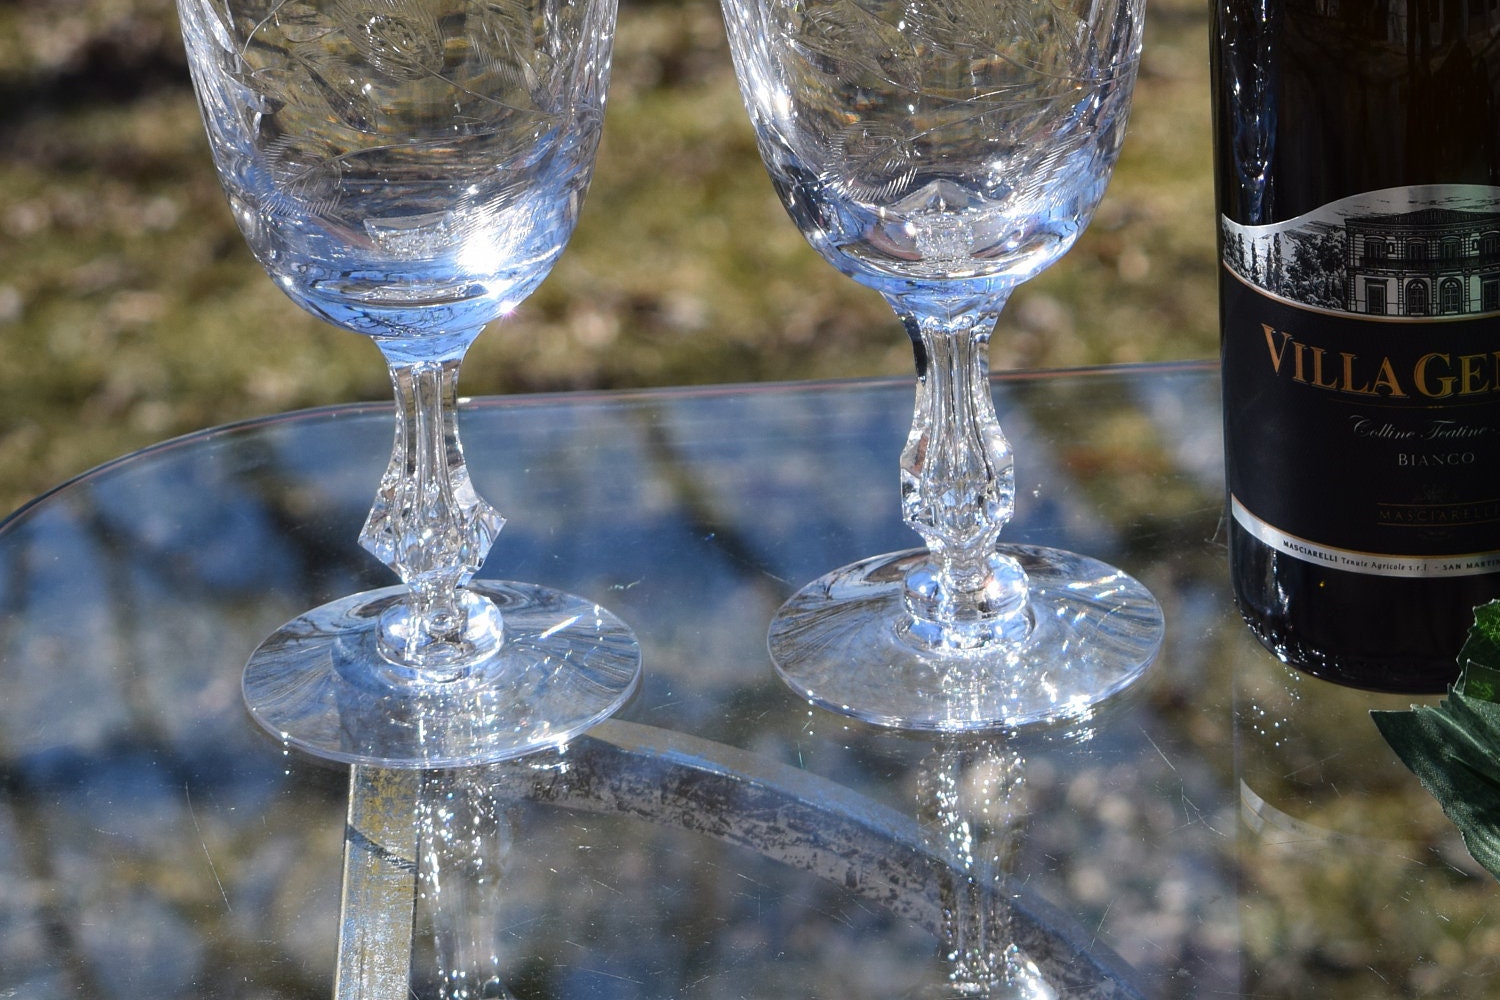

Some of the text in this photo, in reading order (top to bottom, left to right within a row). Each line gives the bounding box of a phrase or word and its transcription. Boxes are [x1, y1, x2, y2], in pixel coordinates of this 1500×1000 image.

[1261, 323, 1410, 399] VILLA
[1349, 414, 1416, 440] Colline
[1420, 419, 1488, 441] Teatine
[1398, 452, 1475, 467] BIANCO
[1379, 504, 1498, 522] MASCIARELLI
[1283, 540, 1338, 563] MASCIARELLI
[1341, 557, 1368, 568] Tenute
[1371, 561, 1405, 571] Agricole
[1442, 563, 1461, 571] SAN
